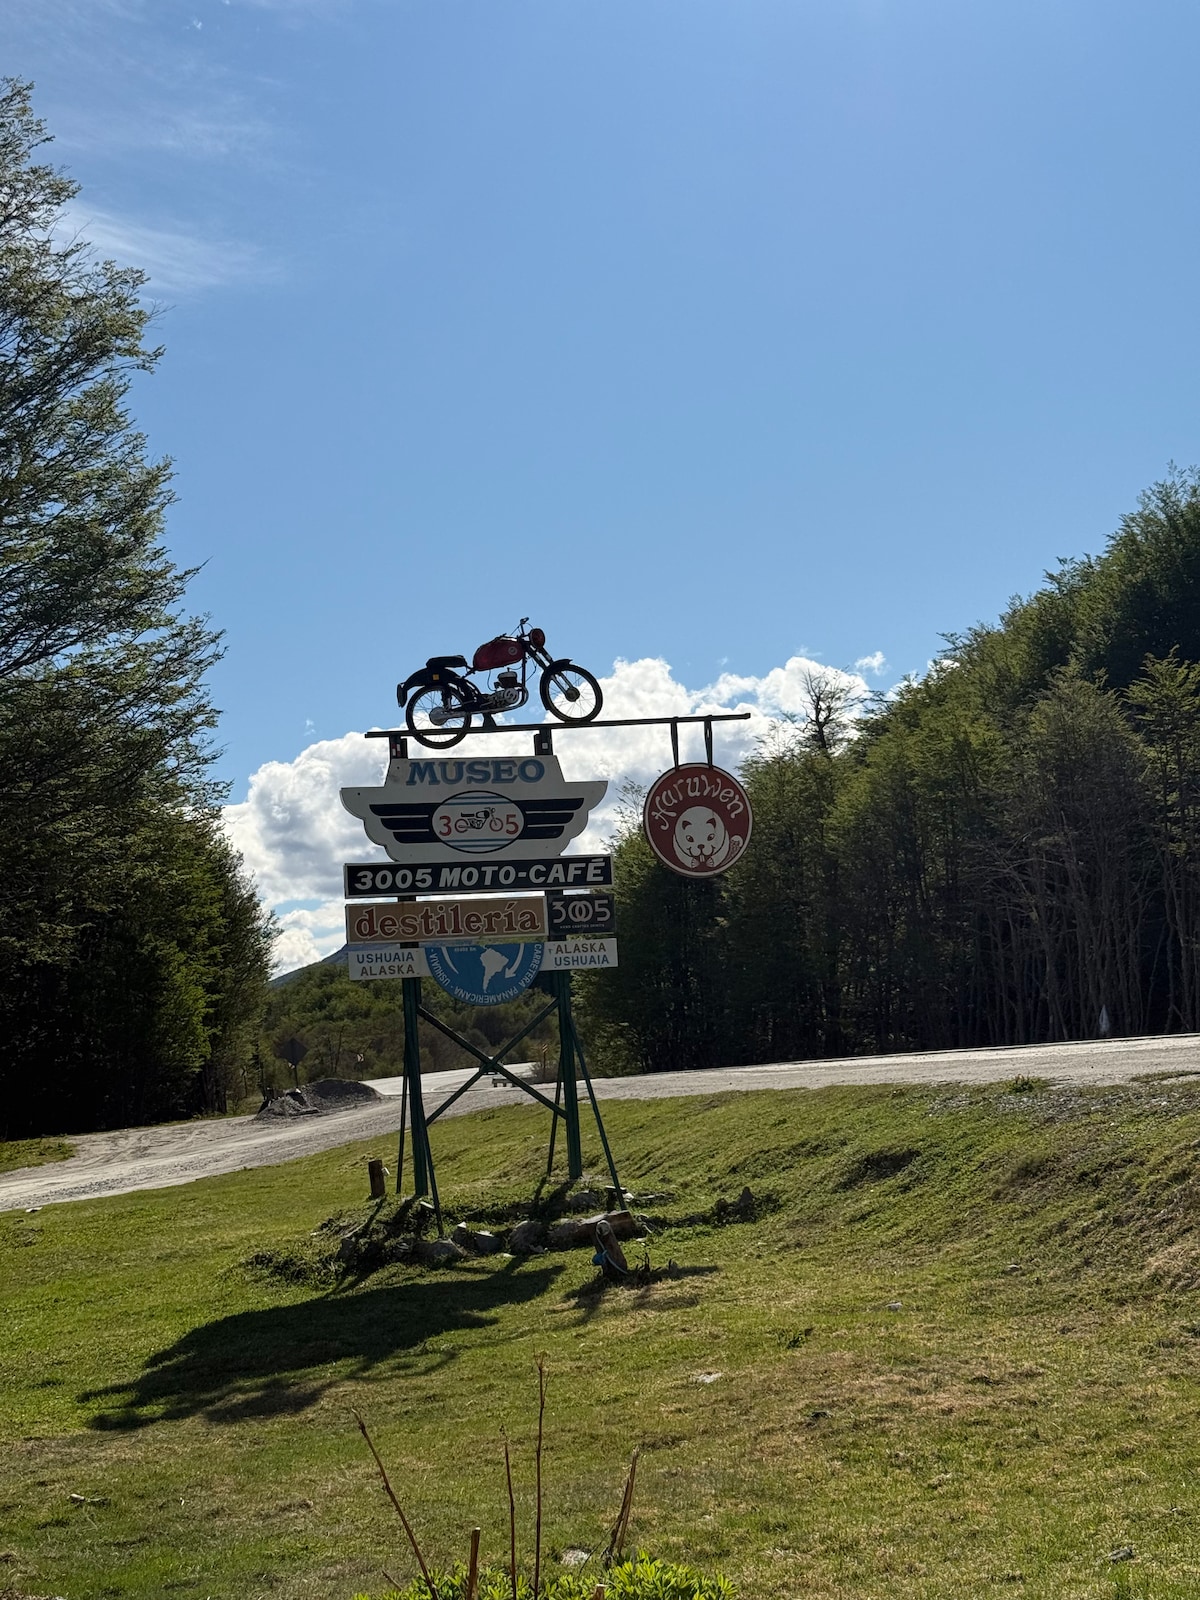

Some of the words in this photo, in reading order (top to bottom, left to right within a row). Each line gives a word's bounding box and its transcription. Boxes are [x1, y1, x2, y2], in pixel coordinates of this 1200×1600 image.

[405, 758, 545, 786] MUSEO
[354, 867, 433, 890] 3005
[438, 858, 605, 888] MOTO-CAFÉ
[354, 901, 541, 940] destilería
[552, 899, 611, 924] 3005
[356, 952, 415, 964] USHUAIA
[554, 954, 610, 967] USHUAIA
[555, 942, 607, 955] ALASKA
[360, 964, 415, 977] ALASKA
[429, 952, 451, 987] USHUAIA
[519, 943, 543, 988] CARRETERA
[454, 986, 519, 1004] PANAMERICANA
